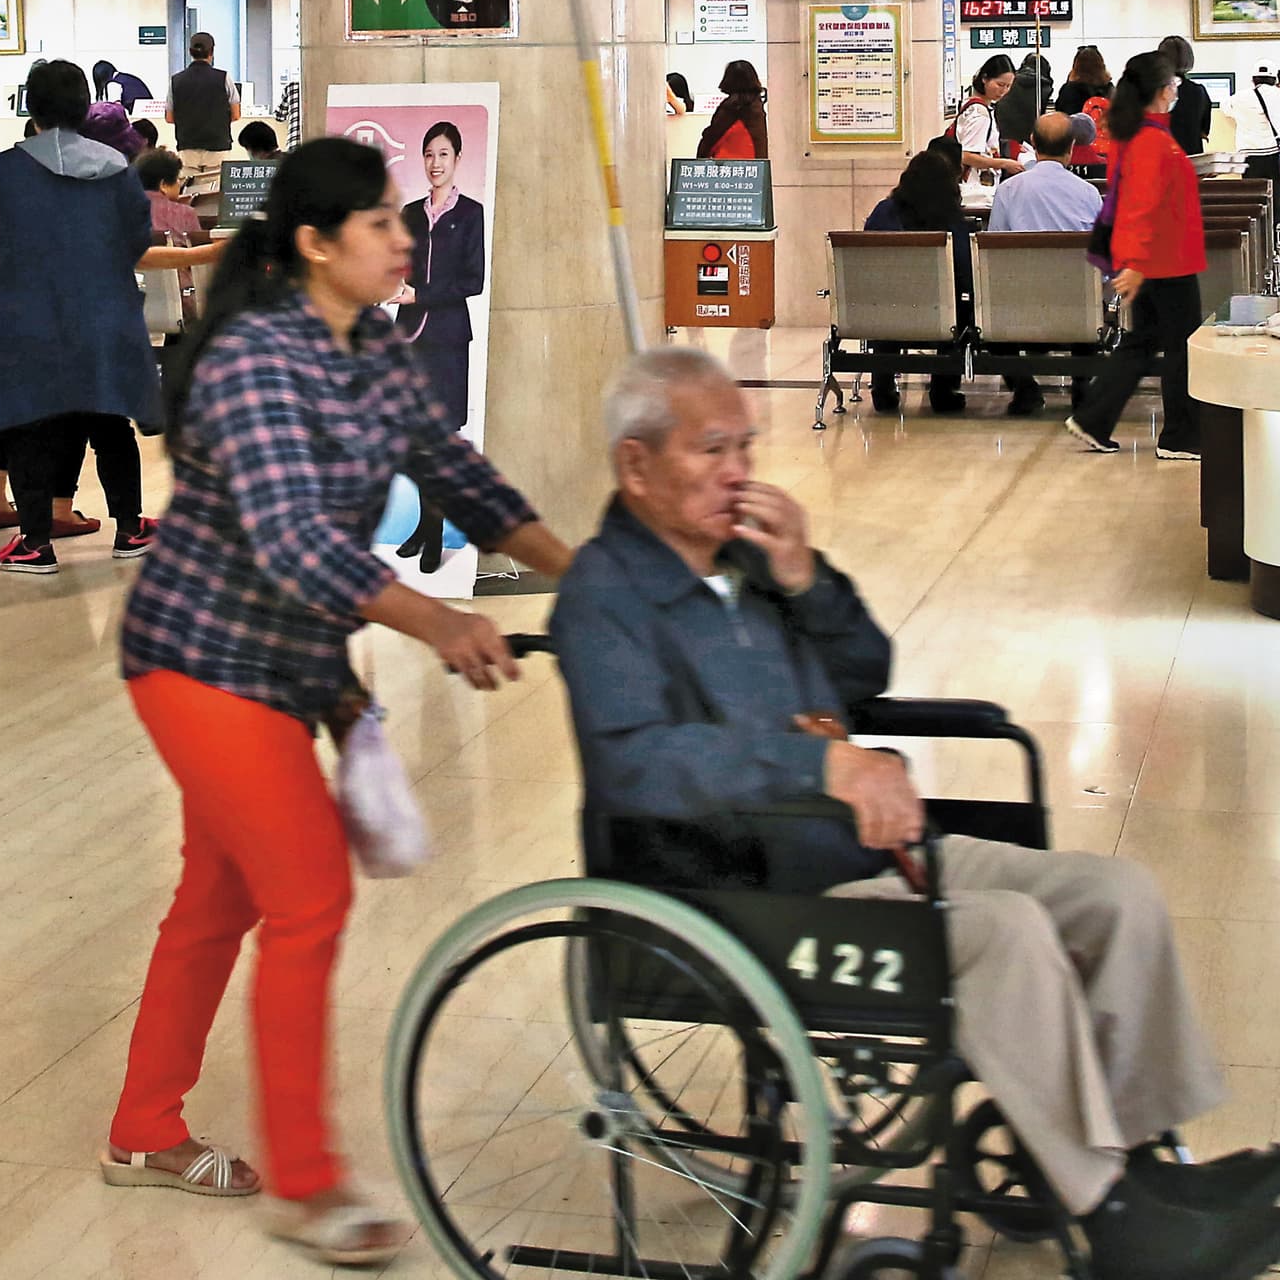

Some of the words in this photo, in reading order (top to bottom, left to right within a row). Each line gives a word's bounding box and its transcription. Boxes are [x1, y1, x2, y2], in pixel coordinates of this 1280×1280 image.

[964, 1, 1003, 15] 1627
[1033, 0, 1049, 15] 15
[978, 28, 1043, 45] 單號區
[680, 165, 758, 178] 取票服務時間
[786, 937, 905, 993] 422
